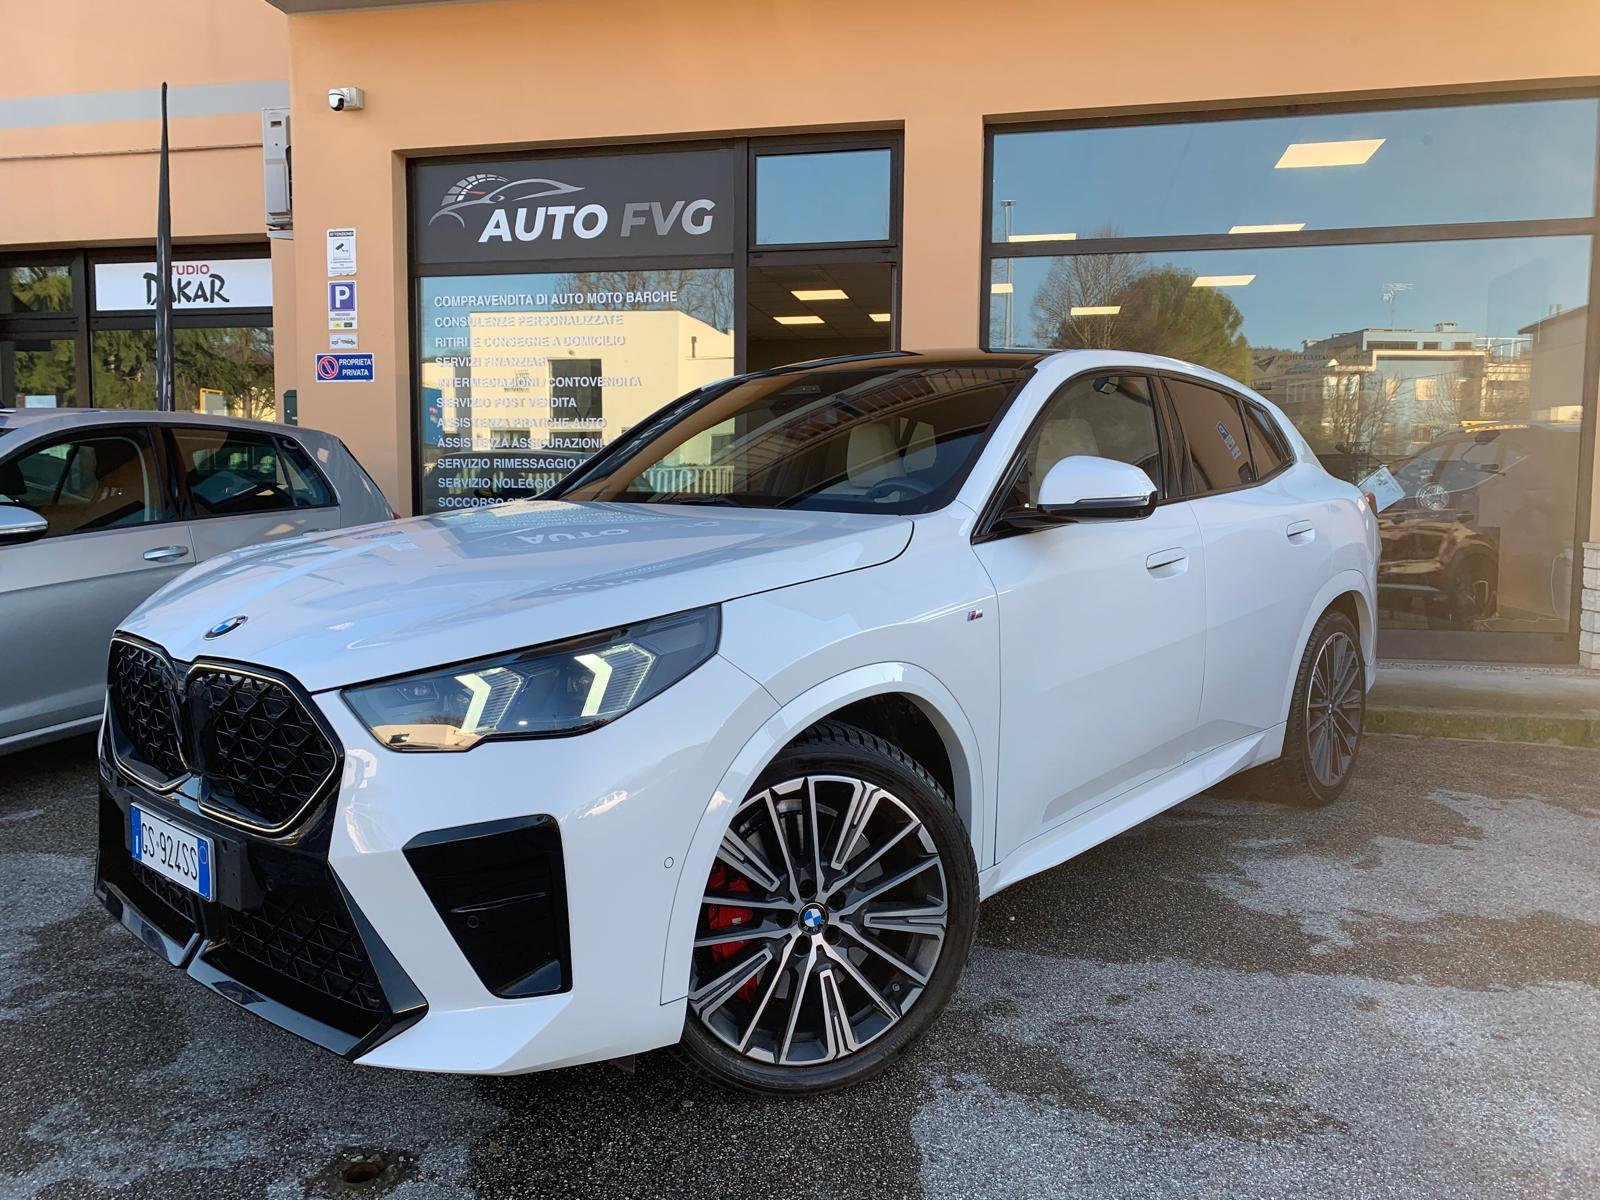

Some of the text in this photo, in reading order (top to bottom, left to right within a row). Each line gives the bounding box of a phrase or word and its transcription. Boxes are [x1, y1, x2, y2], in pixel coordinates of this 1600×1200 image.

[478, 199, 716, 243] AUTO FVG
[171, 264, 210, 276] UDIO
[335, 285, 350, 308] P
[434, 290, 678, 307] COMPRAVENDITA DI AUTO MOTO BARCHE
[434, 314, 624, 328] CONSULENZE PERSONALIZZATE
[435, 335, 626, 348] RITIRI E CONSEGNE A DOMICILIO
[435, 356, 482, 368] SERVIZI
[342, 368, 369, 376] PRIVATA
[548, 376, 643, 388] CONTOVENDITA
[436, 397, 577, 408] SERVIZIO POST VENDITA
[437, 417, 607, 429] ASSISTENZA PRATICHE AUTO
[437, 437, 603, 449] ASSISTENZA ASSICURAZIONI
[437, 459, 490, 469] SERVIZIO
[493, 458, 577, 469] RIMESSAGGIO
[438, 478, 556, 488] SERVIZIO NOLEGGIO
